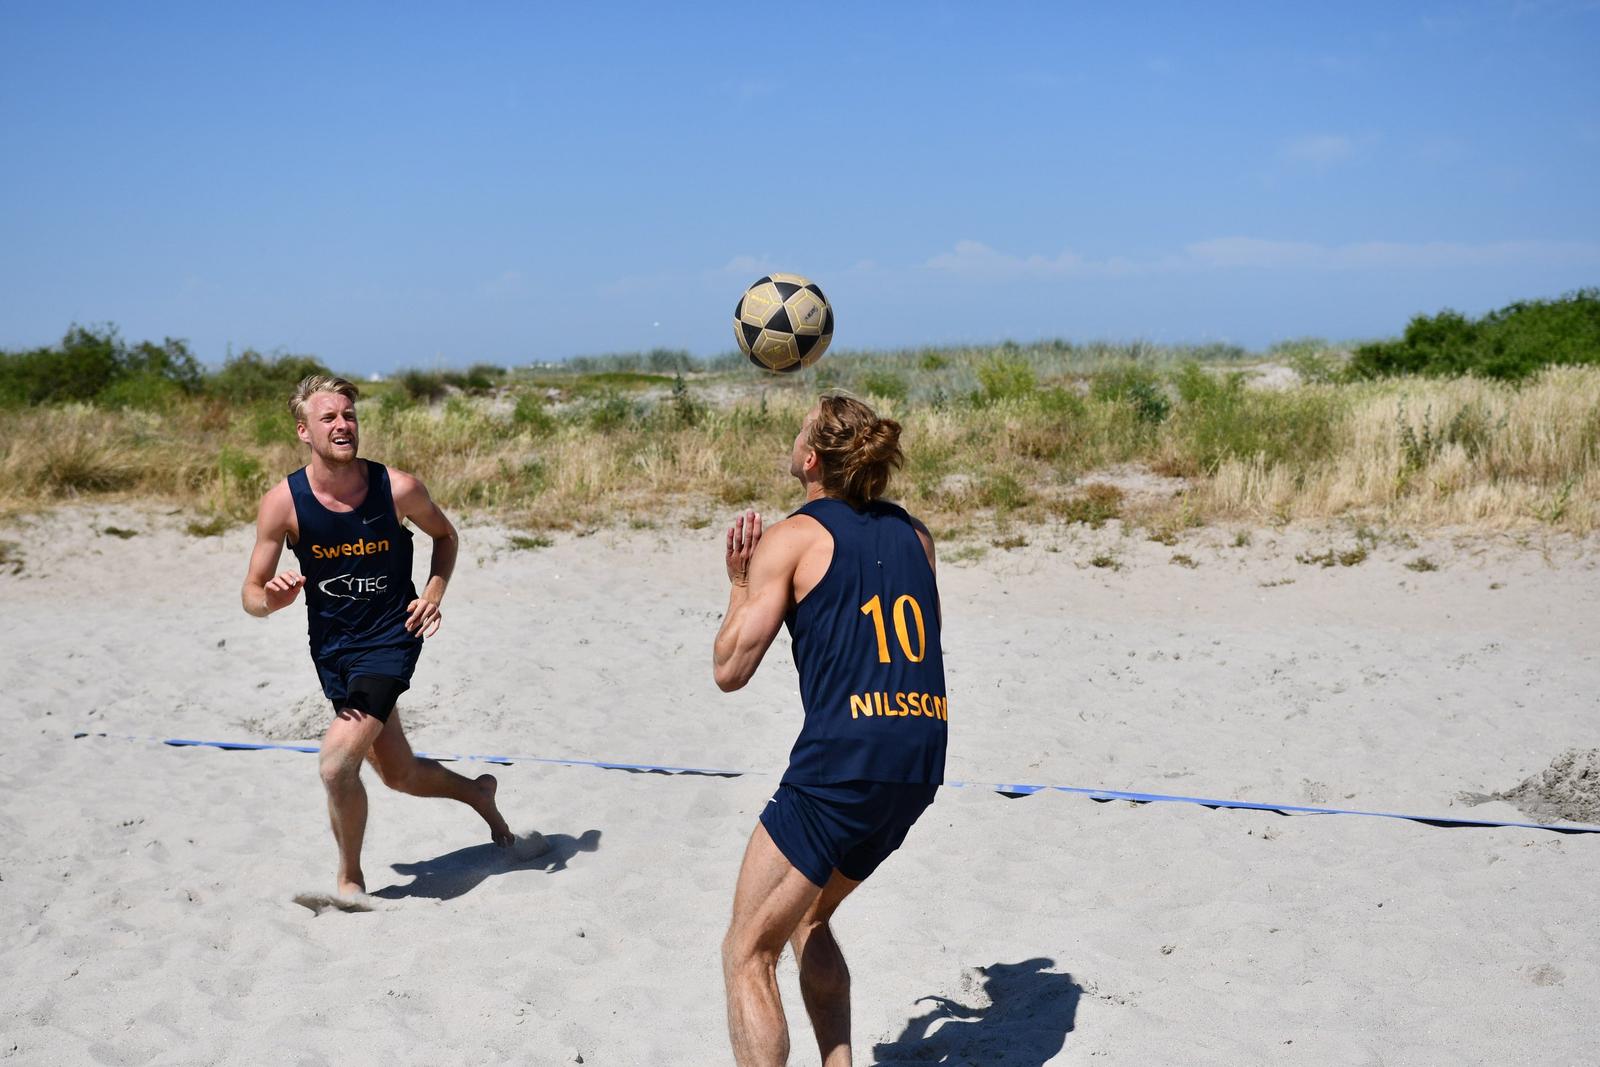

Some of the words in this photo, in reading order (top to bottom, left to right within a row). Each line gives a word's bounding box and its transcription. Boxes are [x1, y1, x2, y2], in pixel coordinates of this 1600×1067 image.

[311, 538, 389, 559] Sweden
[860, 594, 926, 664] 10
[850, 691, 949, 722] NILSSON
